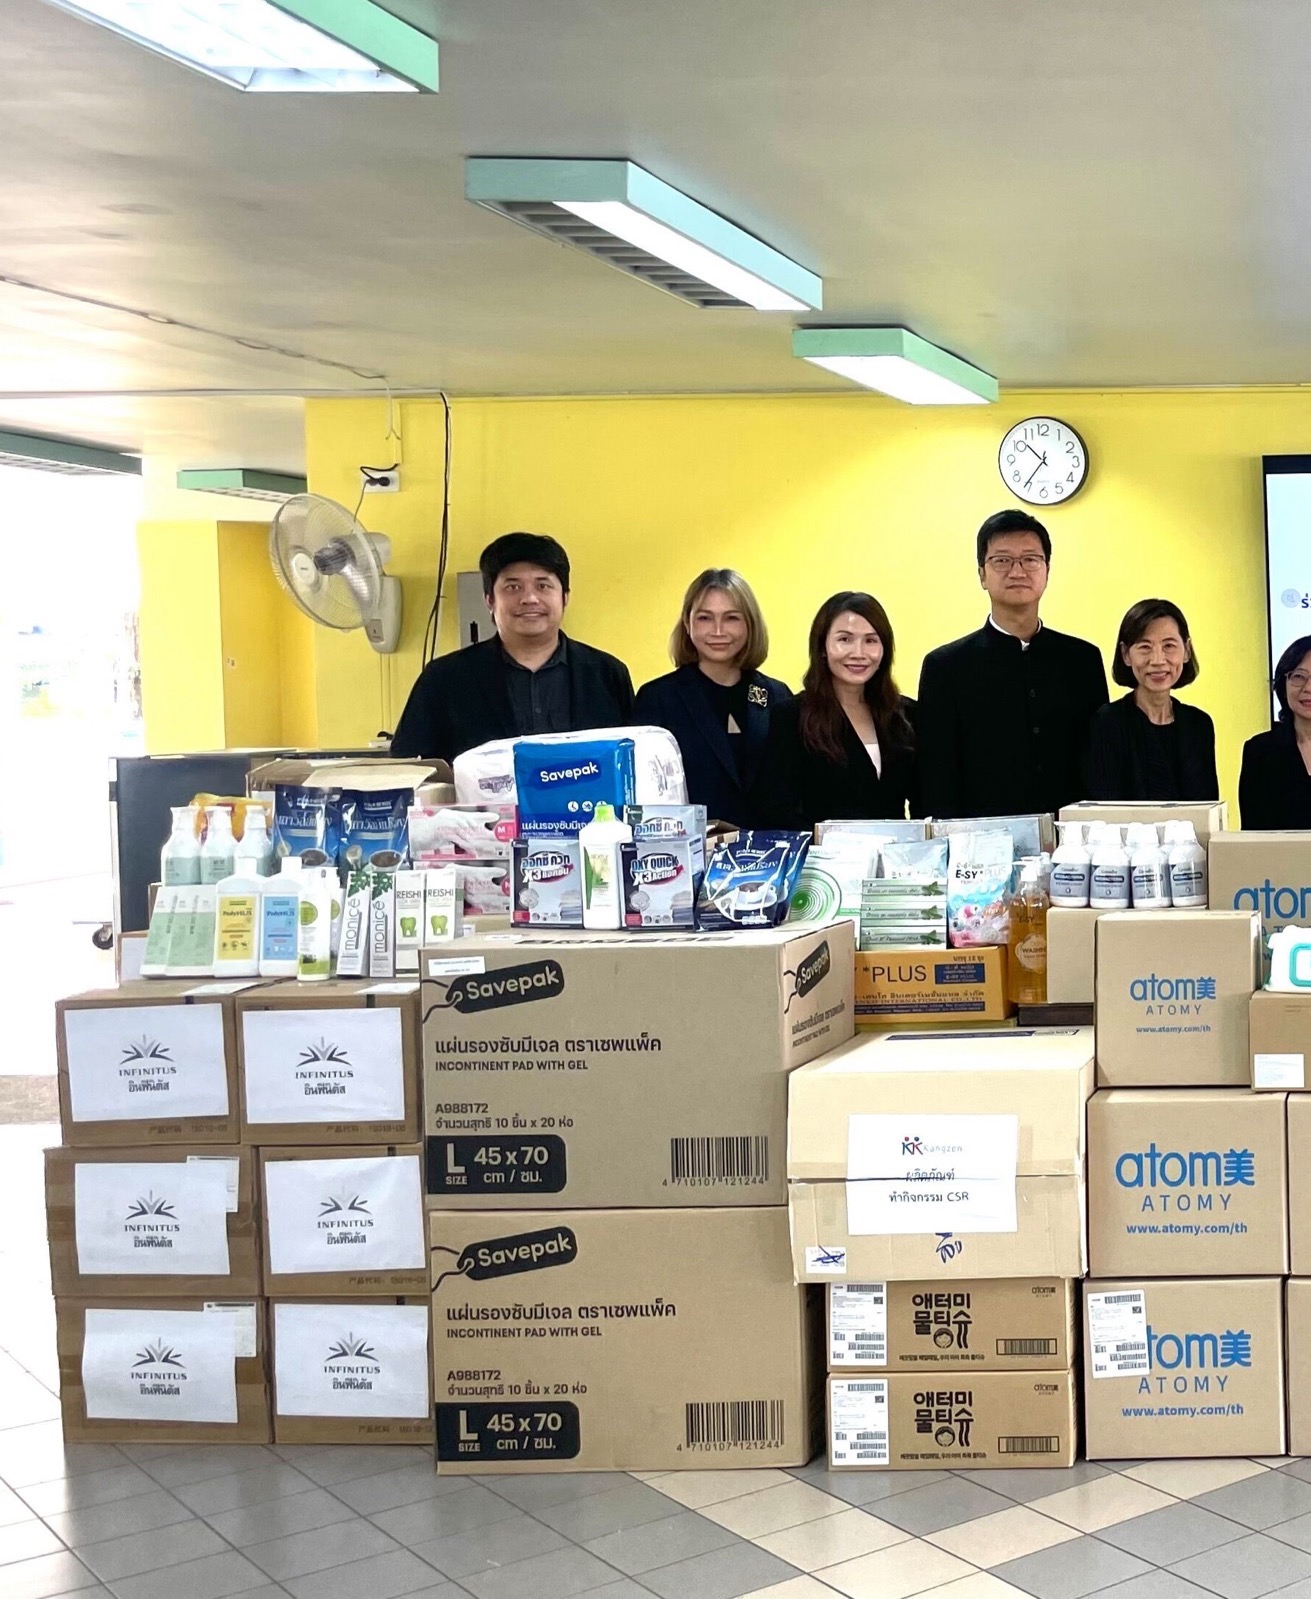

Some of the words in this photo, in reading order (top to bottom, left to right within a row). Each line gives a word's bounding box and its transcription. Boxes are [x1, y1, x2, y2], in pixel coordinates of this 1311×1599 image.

[1024, 428, 1033, 440] 11
[1037, 424, 1049, 436] 12
[1057, 429, 1061, 441] 1
[1014, 440, 1027, 452] 10
[1066, 441, 1074, 453] 2
[1007, 454, 1016, 466] 9
[1072, 456, 1080, 468] 3
[1013, 470, 1021, 482] 8
[1066, 472, 1074, 482] 4
[1040, 487, 1048, 498] 6
[1055, 482, 1063, 494] 5
[540, 762, 598, 782] Savepak
[522, 820, 587, 830] แผ่นรองซับมีเจ
[631, 859, 648, 871] OXY
[651, 856, 679, 869] QUICK
[956, 870, 977, 878] E-SY
[428, 889, 454, 897] REISHI
[345, 898, 360, 950] monicé
[373, 900, 385, 953] monicé
[801, 948, 829, 984] Savepak
[872, 965, 926, 982] PLUS
[466, 966, 559, 1000] Savepak
[1130, 973, 1215, 1000] atom美
[1146, 1005, 1201, 1015] ATOMY
[1136, 1024, 1211, 1034] www.atomy.com/th
[435, 1036, 559, 1053] แผ่นรองซับมีเจล
[565, 1032, 661, 1052] ตราเซพแพ็ค
[119, 1067, 177, 1076] INFINITUS
[435, 1061, 509, 1071] INCONTINENT
[513, 1061, 533, 1070] PAD
[536, 1060, 565, 1070] WITH
[568, 1060, 588, 1070] GEL
[296, 1070, 353, 1079] INFINITUS
[435, 1103, 488, 1114] A988172
[496, 1118, 508, 1128] 10
[541, 1118, 555, 1127] 20
[559, 1116, 573, 1127] ห่อ
[923, 1144, 962, 1153] Kangzen
[447, 1143, 465, 1173] L
[474, 1147, 501, 1165] 45
[506, 1151, 517, 1164] x
[520, 1147, 548, 1164] 70
[1115, 1143, 1255, 1187] atom美
[446, 1176, 467, 1185] SIZE
[484, 1172, 504, 1182] cm
[906, 1168, 954, 1182] ผลิตภัณฑ์
[677, 1178, 717, 1186] 710107
[725, 1177, 764, 1186] 121244
[889, 1191, 942, 1202] ทำกิจกรรม
[947, 1192, 968, 1201] CSR
[1142, 1194, 1232, 1211] ATOMY
[125, 1224, 179, 1232] INFINITUS
[318, 1220, 373, 1228] INFINITUS
[1126, 1222, 1247, 1235] www.atomy.com/th
[478, 1234, 572, 1267] Savepak
[912, 1293, 970, 1309] 애터미
[447, 1303, 572, 1320] แผ่นรองซับมีเจล
[578, 1298, 676, 1318] ตราเซพแพ็ค
[447, 1328, 521, 1338] INCONTINENT
[525, 1328, 546, 1337] PAD
[549, 1327, 578, 1337] WITH
[582, 1327, 602, 1336] GEL
[913, 1310, 972, 1348] 물티슈
[1147, 1325, 1252, 1369] tom美
[131, 1372, 187, 1380] INFINITUS
[324, 1366, 380, 1374] INFINITUS
[447, 1370, 501, 1381] A988172
[509, 1385, 520, 1394] 10
[554, 1385, 568, 1394] 20
[573, 1382, 587, 1394] ห่อ
[1139, 1376, 1228, 1394] ATOMY
[914, 1391, 972, 1407] 애터미
[1122, 1404, 1243, 1417] www.atomy.com/th
[459, 1410, 478, 1440] L
[487, 1414, 514, 1432] 45
[519, 1418, 531, 1431] x
[534, 1414, 562, 1431] 70
[915, 1408, 974, 1446] 물티슈
[459, 1443, 480, 1451] SIZE
[497, 1439, 518, 1449] cm
[691, 1442, 732, 1451] 710107
[740, 1441, 779, 1450] 121244
